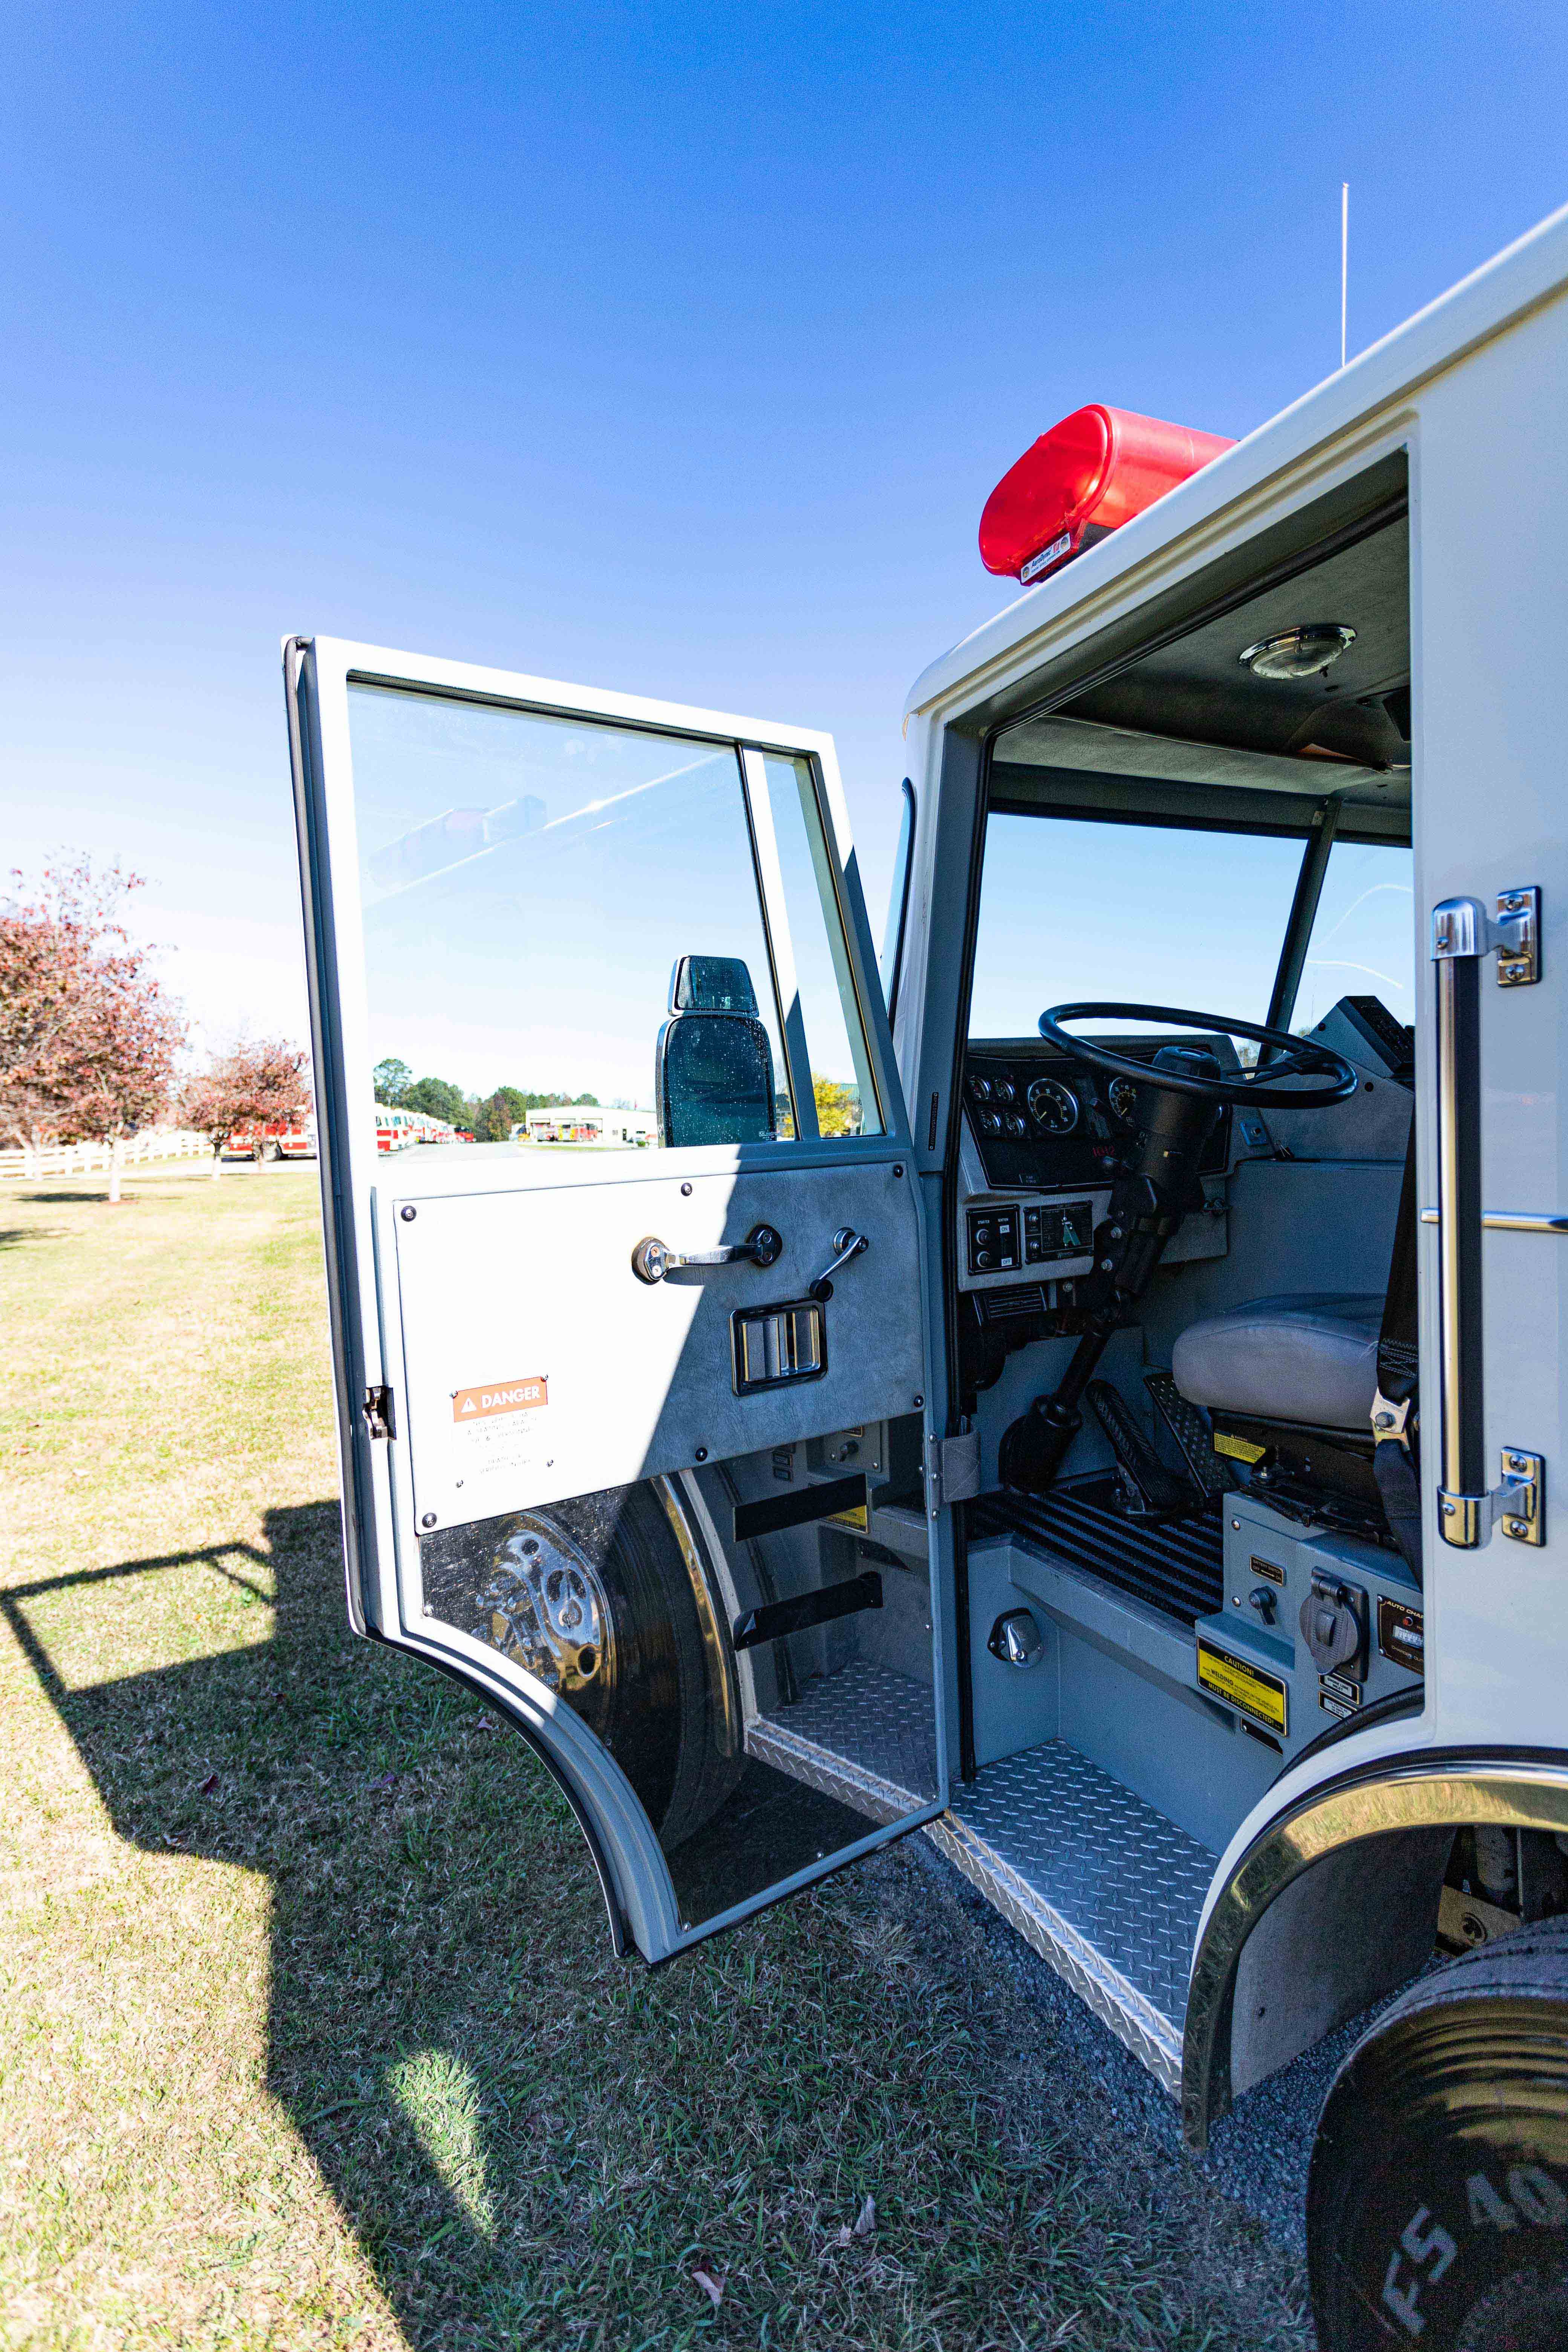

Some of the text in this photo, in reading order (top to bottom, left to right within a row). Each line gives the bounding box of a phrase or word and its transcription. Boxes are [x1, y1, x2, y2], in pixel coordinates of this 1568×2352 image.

[481, 1386, 540, 1409] DANGER
[1387, 1601, 1405, 1611] AUTO
[1210, 1669, 1234, 1686] WELDING
[1224, 1656, 1254, 1677] CAUTION!
[1208, 1682, 1274, 1724] MUST BE DISCONNECTED!
[1382, 2204, 1459, 2337] FS
